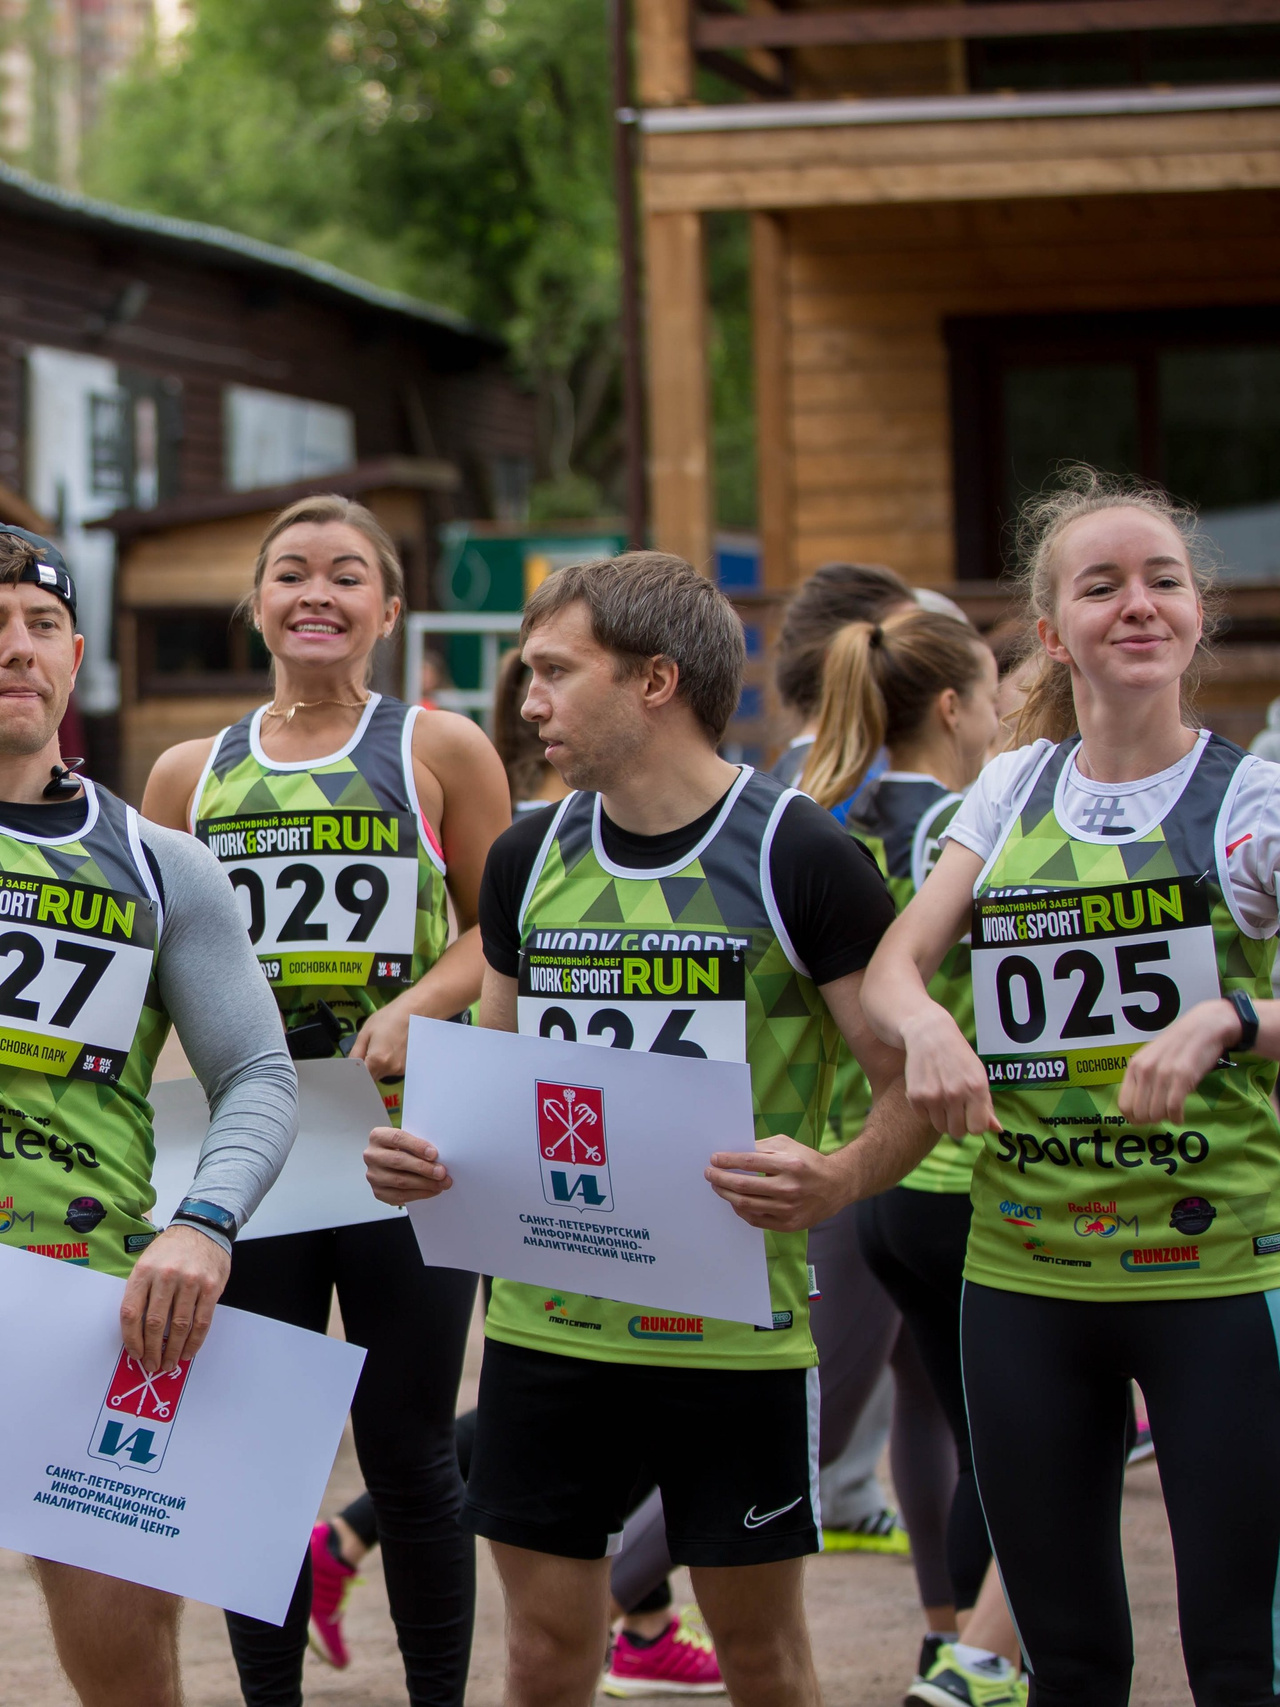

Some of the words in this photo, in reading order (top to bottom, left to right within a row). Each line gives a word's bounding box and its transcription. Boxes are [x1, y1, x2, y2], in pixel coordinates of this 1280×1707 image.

[208, 816, 279, 833] КОРПОРАТИВНЫЙ
[280, 816, 311, 827] ЗАБЕГ
[313, 815, 399, 852] RUN
[6, 879, 39, 892] ЗАБЕГ
[37, 884, 137, 939] RUN
[227, 863, 390, 946] 029
[981, 899, 1047, 914] КОРПОРАТИВНЫЙ
[1049, 898, 1078, 909] ЗАБЕГ
[982, 909, 1081, 942] WORK&SPORT
[1081, 885, 1184, 934] RUN
[289, 961, 338, 974] СОСНОВКА
[339, 961, 363, 974] ПАРК
[530, 955, 591, 967] КОРПОРАТИВНЫЙ
[592, 958, 621, 967] ЗАБЕГ
[530, 966, 621, 994] WORK&SPORT
[623, 957, 720, 995] RUN
[996, 940, 1181, 1044] 025
[40, 1046, 68, 1063] ПАРК
[988, 1060, 1066, 1081] 14.07.2019
[1076, 1057, 1128, 1074] СОСНОВКА
[996, 1129, 1209, 1176] sportego
[999, 1200, 1042, 1220] ФРОСТ
[1068, 1202, 1092, 1213] Red
[1093, 1201, 1117, 1213] Bull
[519, 1213, 650, 1240] САНКТ-ПЕТЕРБУРГСКИЙ
[531, 1226, 642, 1250] ИНФОРМАЦИОННО-
[523, 1236, 618, 1259] АНАЛИТИЧЕСКИЙ
[620, 1250, 656, 1265] ЦЕНТР
[1133, 1246, 1199, 1264] RUNZONE
[1055, 1257, 1092, 1268] cinema
[569, 1319, 601, 1331] cinema
[640, 1316, 703, 1333] RUNZONE
[45, 1464, 187, 1511] САНКТ-ПЕТЕРБУРГСКИЙ
[51, 1480, 171, 1520] ИНФОРМАЦИОННО-
[33, 1491, 138, 1528] АНАЛИТИЧЕСКИЙ
[140, 1519, 180, 1538] ЦЕНТР
